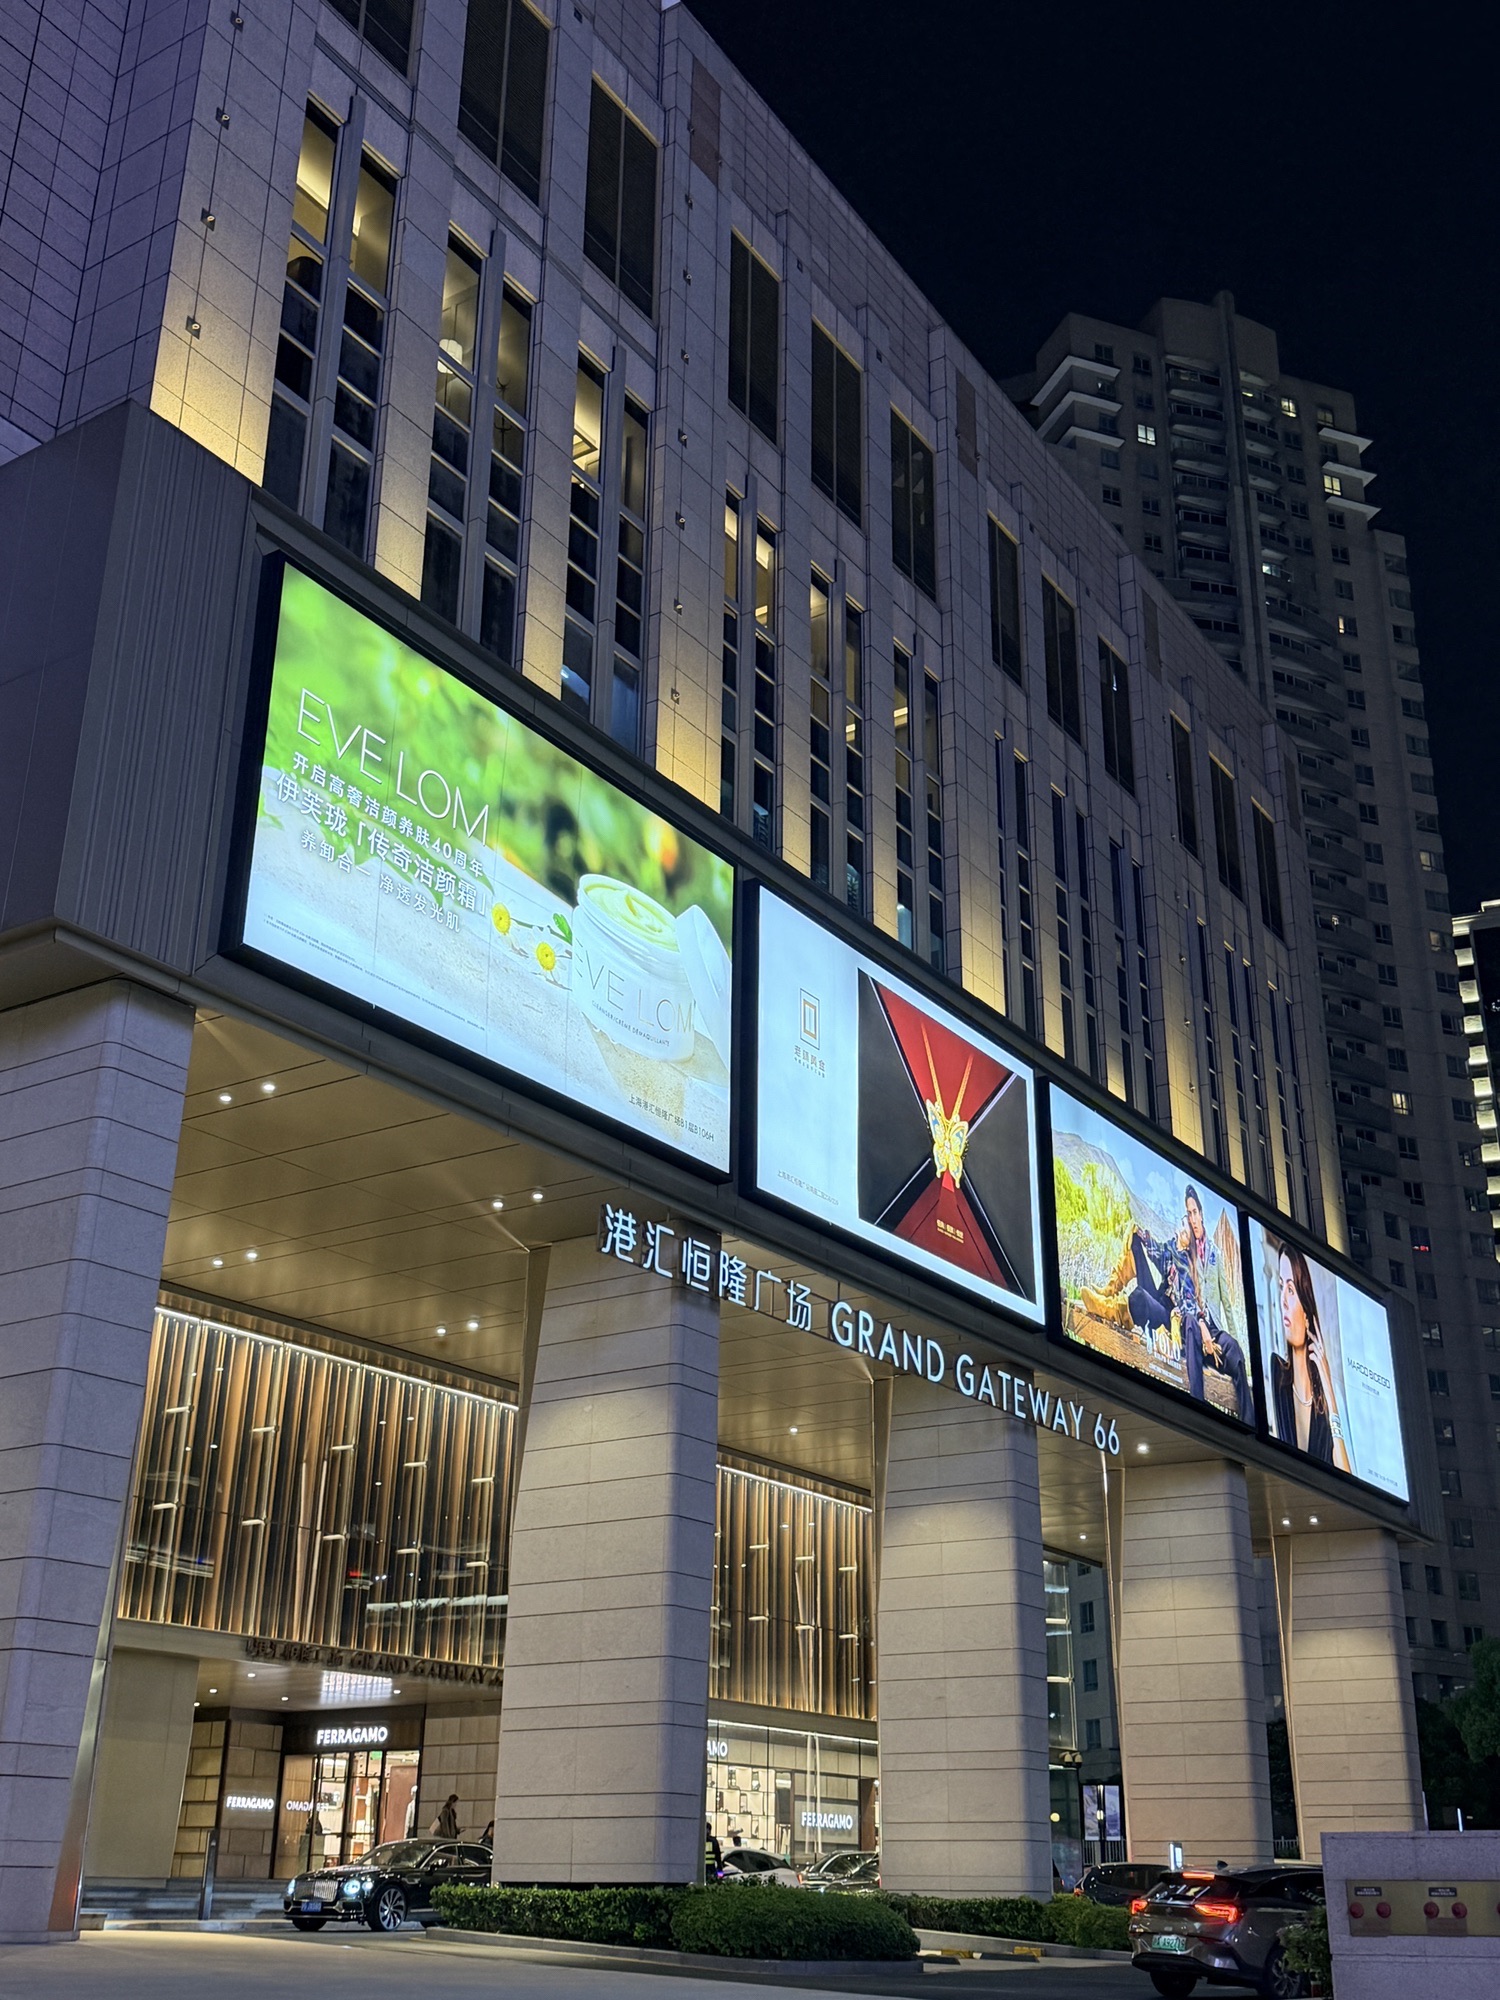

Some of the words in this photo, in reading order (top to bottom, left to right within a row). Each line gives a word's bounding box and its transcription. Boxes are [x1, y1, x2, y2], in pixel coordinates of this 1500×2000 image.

[298, 688, 386, 784] EVE
[396, 751, 489, 846] LOM
[293, 752, 485, 878] 开启高奢洁颜养肤40周年
[301, 829, 371, 876] 养卸合一
[379, 873, 461, 933] 净透发光肌
[601, 1203, 812, 1332] 港汇恒隆广场
[831, 1301, 945, 1384] GRAND
[956, 1354, 1085, 1440] GATEWAY
[1094, 1413, 1120, 1456] 66
[1152, 1328, 1181, 1362] POLO
[316, 1726, 388, 1746] FERRAGAMO
[226, 1795, 275, 1811] FERRAGAMO
[801, 1811, 853, 1830] FERRAGAMO
